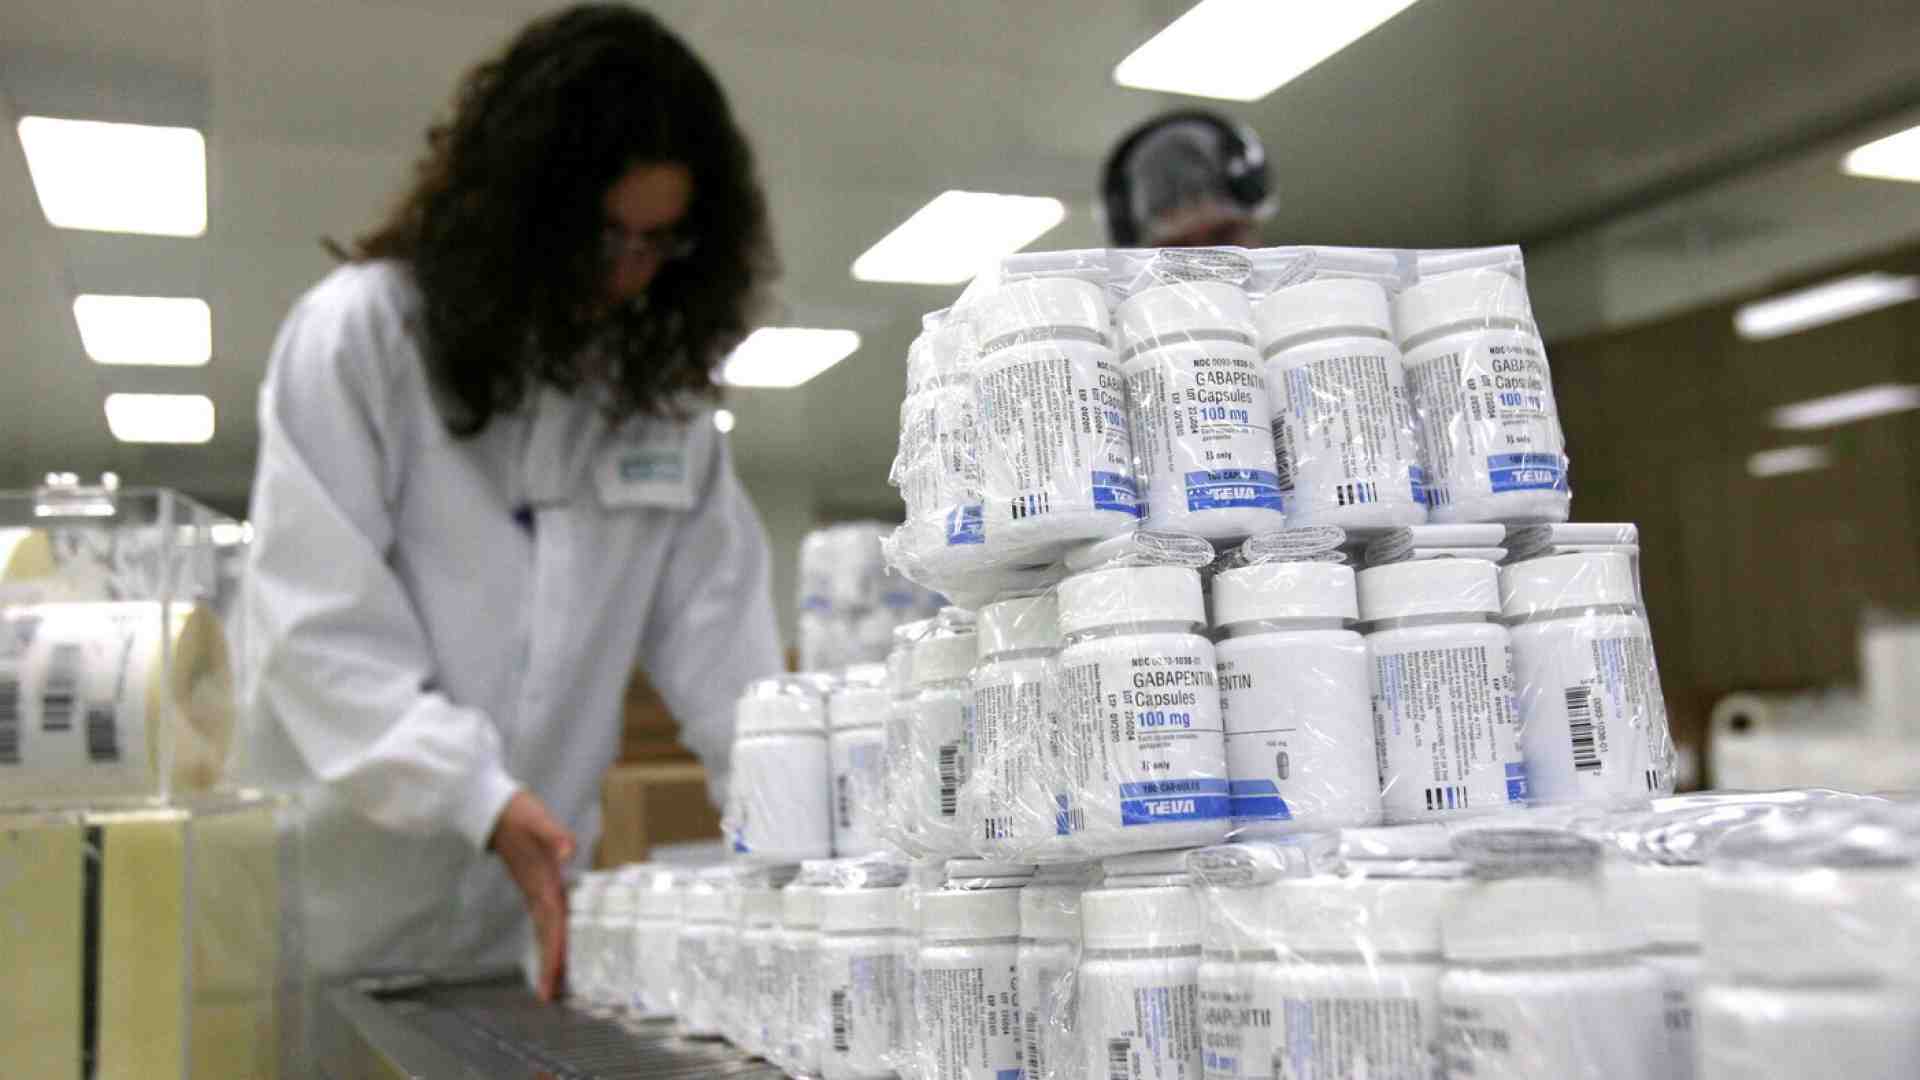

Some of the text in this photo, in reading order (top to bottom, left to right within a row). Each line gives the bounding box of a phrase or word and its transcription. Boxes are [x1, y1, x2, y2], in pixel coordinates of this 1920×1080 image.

[1194, 359, 1210, 368] NDC
[1196, 371, 1264, 390] GABAPENTIN
[1198, 389, 1252, 405] Capsules
[1499, 392, 1521, 407] 100
[1201, 407, 1249, 424] 100 mg
[1511, 470, 1553, 482] TEVA
[1215, 488, 1256, 500] TEVA
[1133, 670, 1214, 689] GABAPENTIN
[1122, 690, 1133, 704] LOT
[1135, 690, 1197, 710] Capsules
[1138, 710, 1190, 729] 100 mg
[1145, 799, 1196, 815] TEVA
